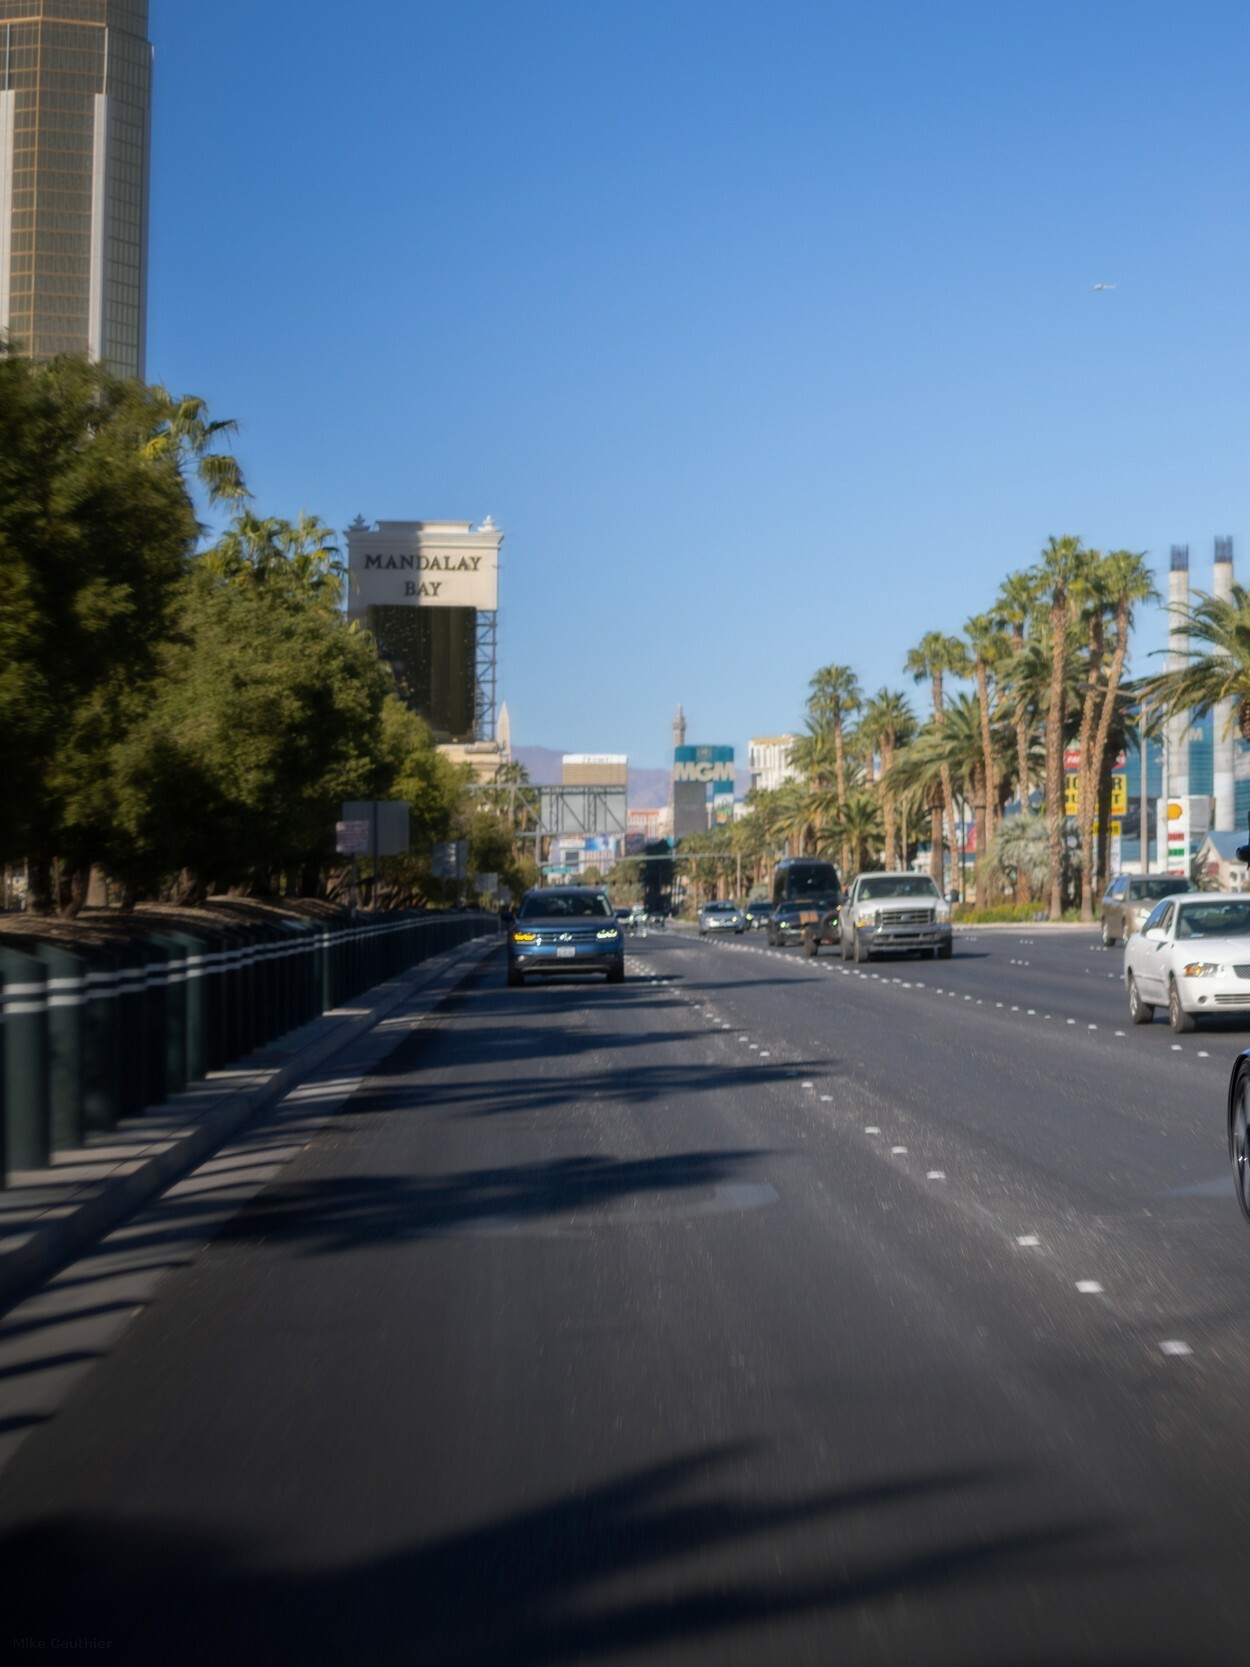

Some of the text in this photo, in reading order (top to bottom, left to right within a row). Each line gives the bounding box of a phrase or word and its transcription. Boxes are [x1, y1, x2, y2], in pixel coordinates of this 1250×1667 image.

[364, 554, 482, 571] MANDALAY
[404, 580, 442, 597] BAY
[674, 761, 735, 783] MGM
